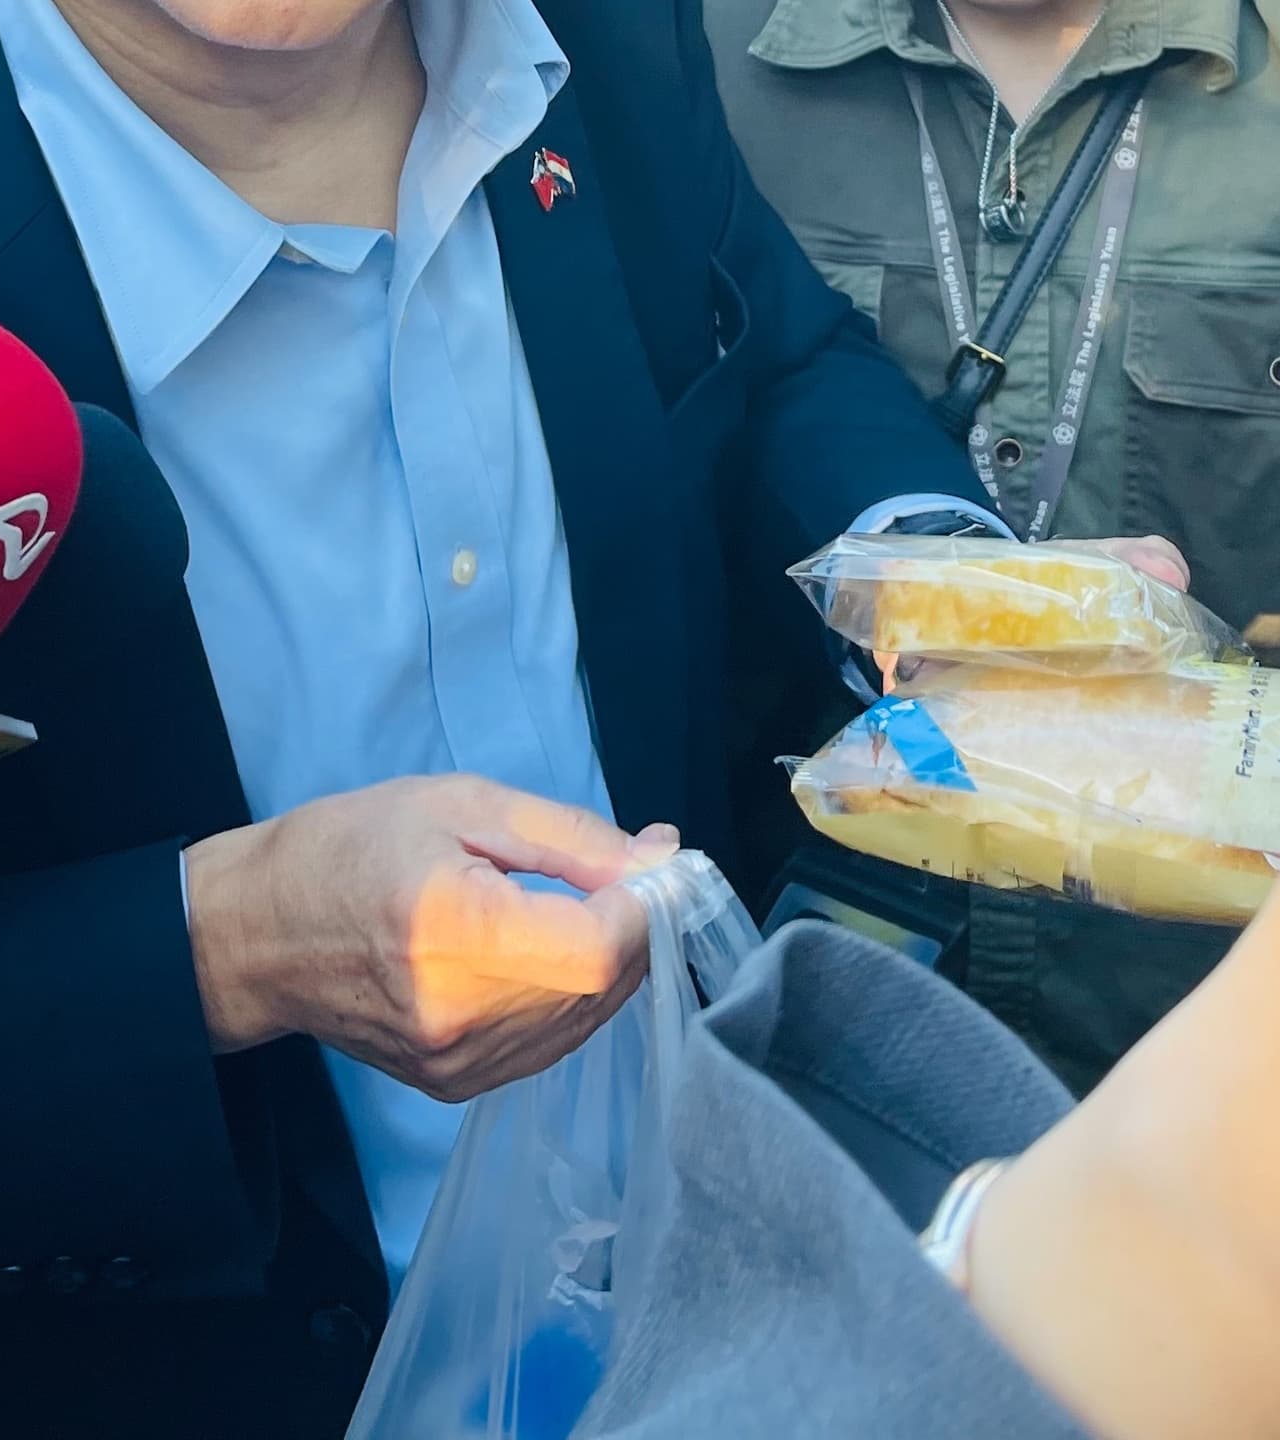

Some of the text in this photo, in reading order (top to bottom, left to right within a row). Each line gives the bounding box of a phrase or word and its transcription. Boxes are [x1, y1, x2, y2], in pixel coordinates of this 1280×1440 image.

[943, 256, 966, 331] Legislative
[1061, 226, 1118, 419] 立法院 The Legislative Yuan
